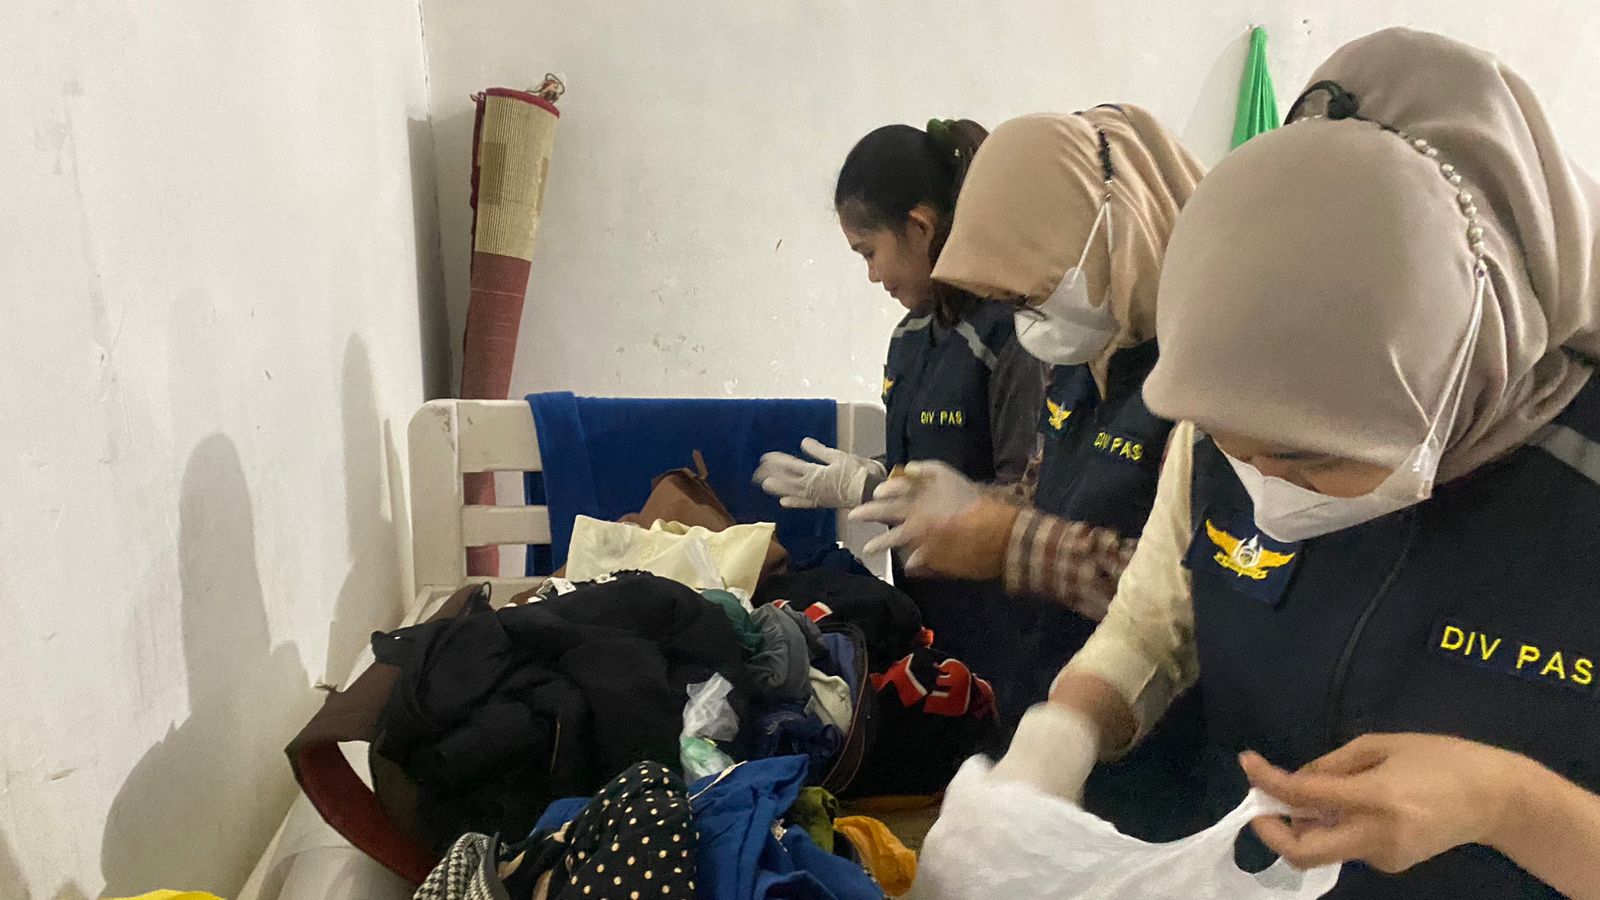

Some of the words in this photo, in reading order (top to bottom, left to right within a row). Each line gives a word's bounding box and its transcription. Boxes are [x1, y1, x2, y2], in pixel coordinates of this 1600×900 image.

[1109, 436, 1143, 461] PAS
[1440, 625, 1502, 661] DIV
[1515, 644, 1594, 685] PAS
